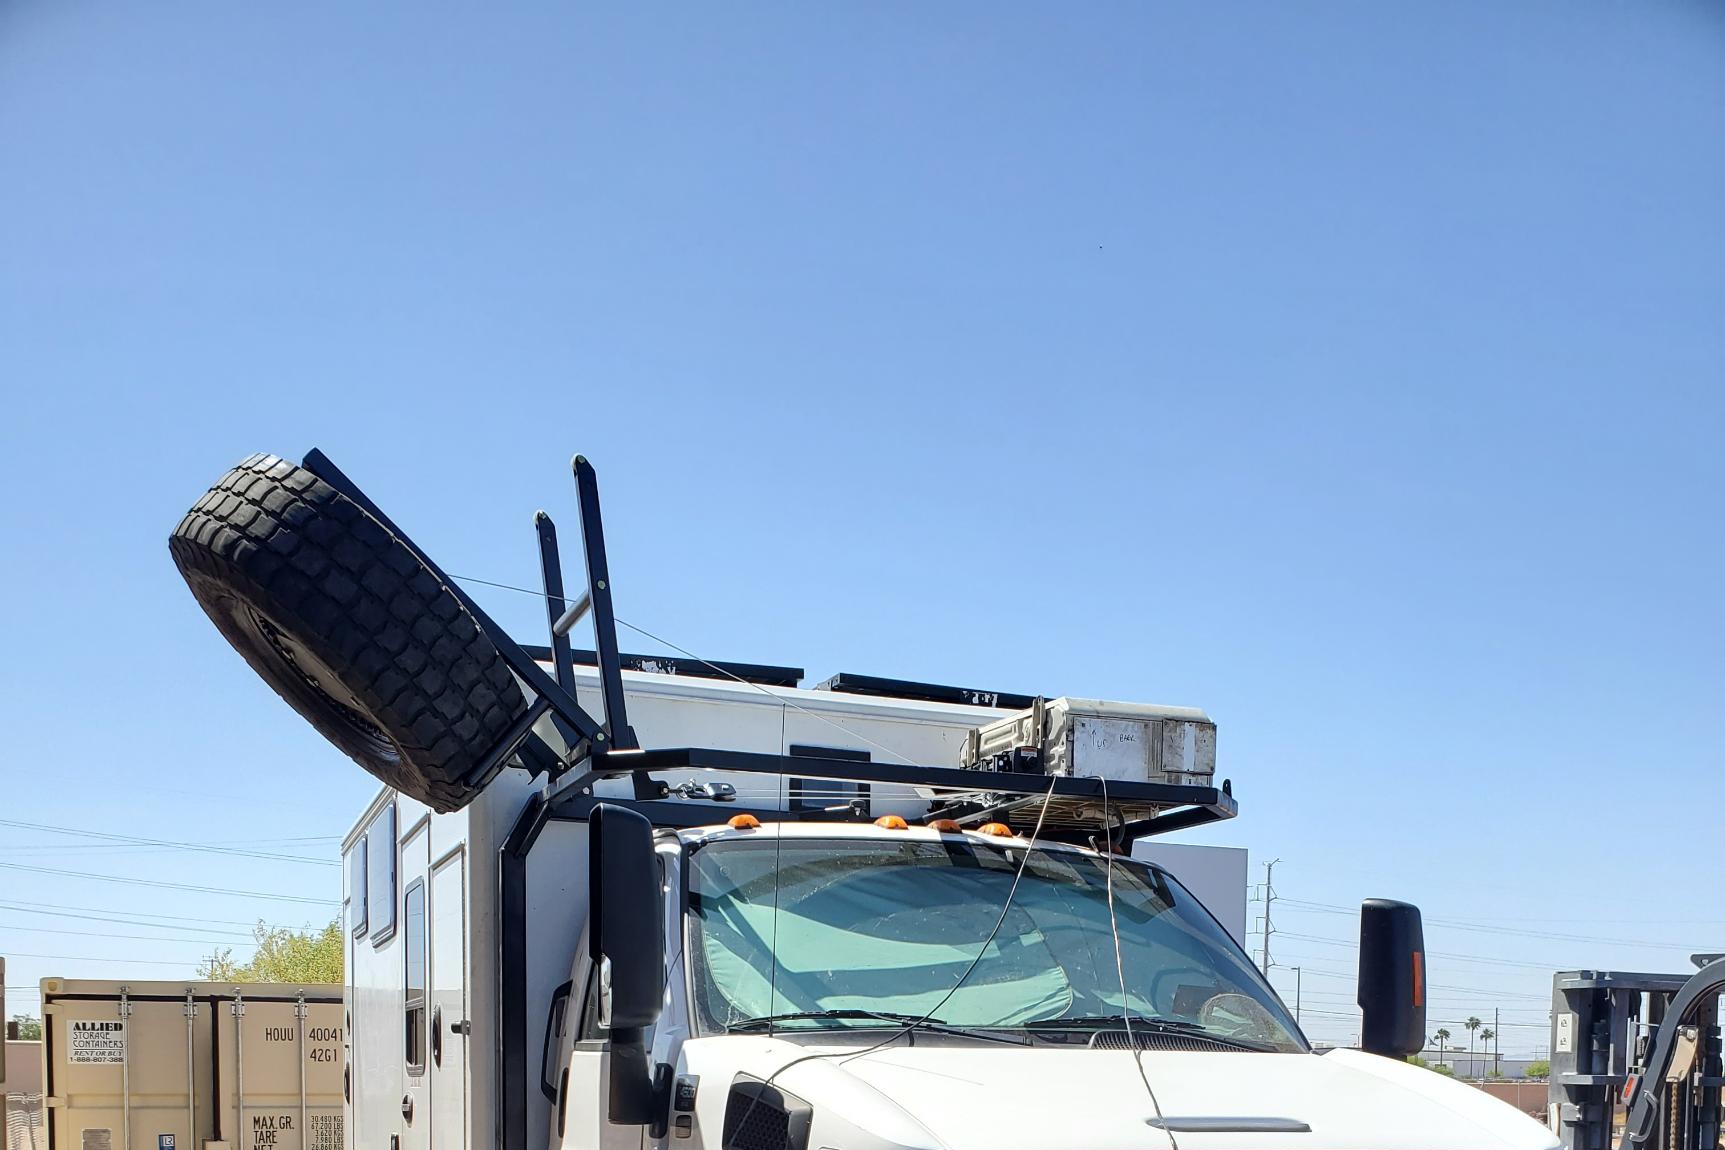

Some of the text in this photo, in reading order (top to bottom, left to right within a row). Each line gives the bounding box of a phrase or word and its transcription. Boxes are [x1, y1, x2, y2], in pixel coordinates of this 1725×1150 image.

[74, 1022, 123, 1031] ALLIED
[265, 1028, 343, 1041] HOUU 40041
[73, 1040, 123, 1048] CONTAINERS
[310, 1049, 337, 1062] 42G1
[254, 1131, 277, 1144] TARE
